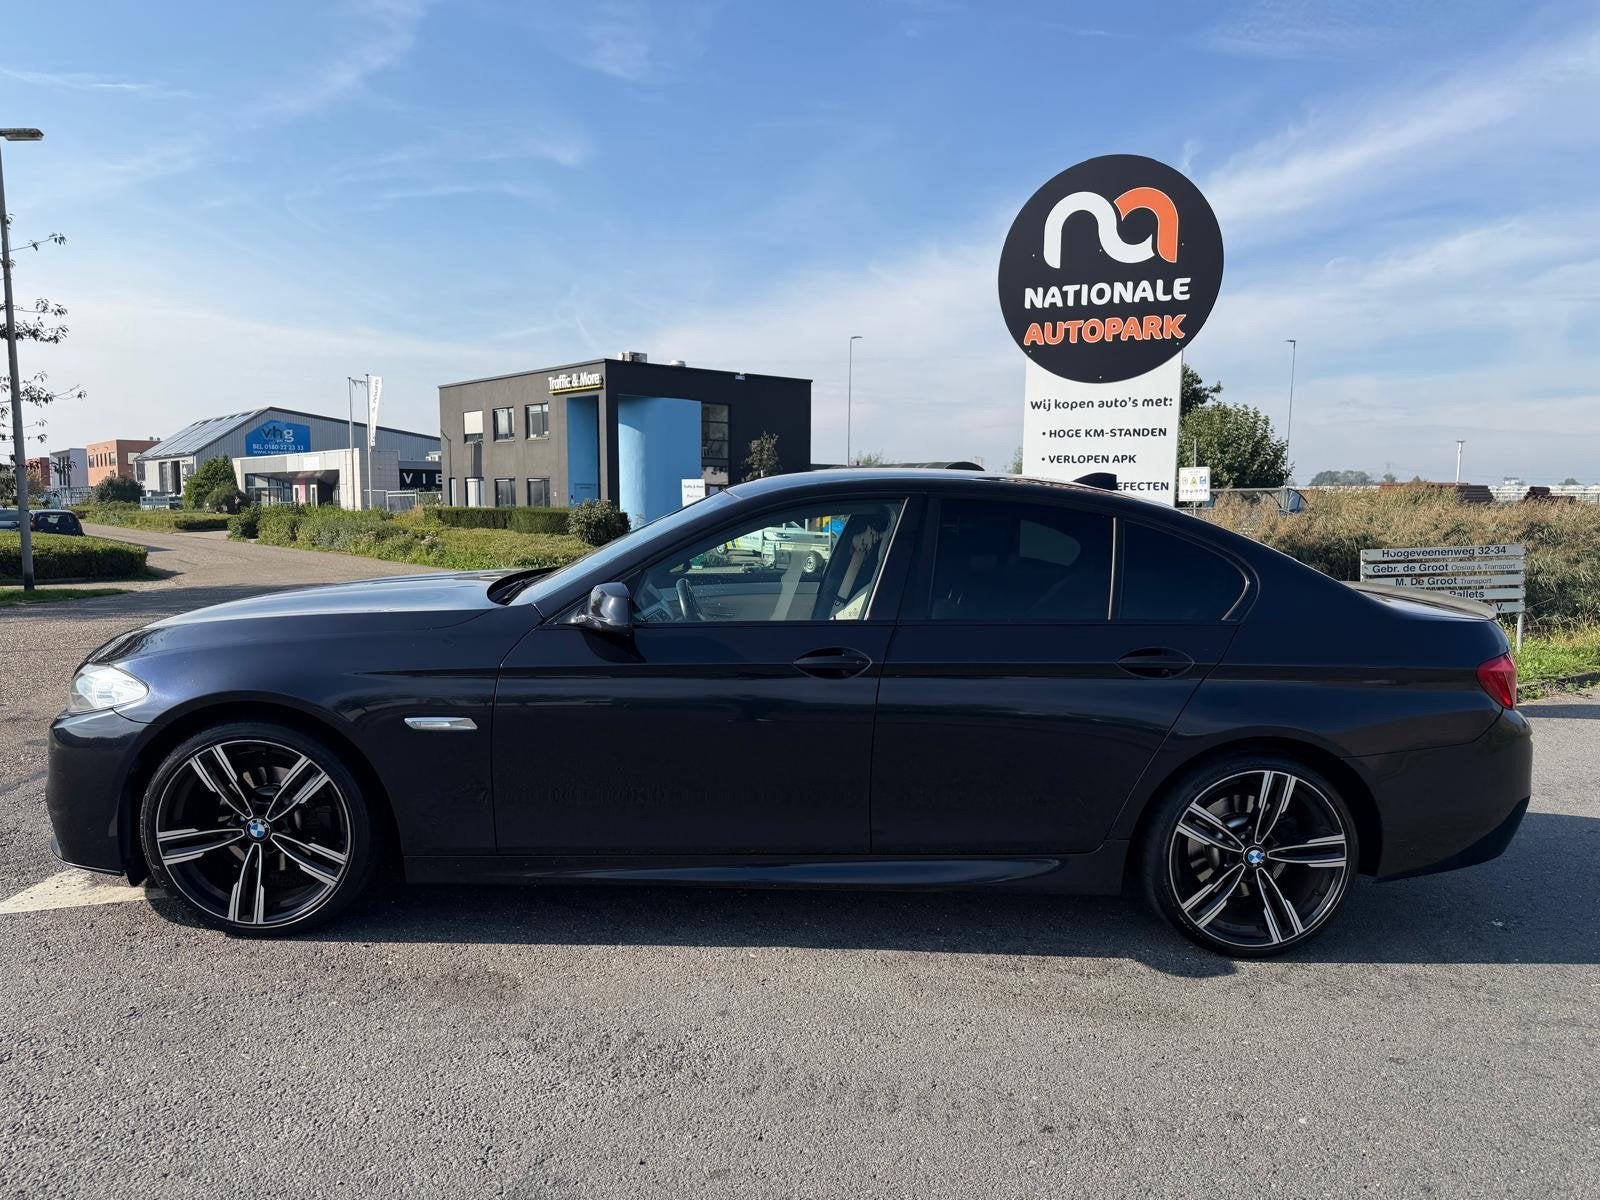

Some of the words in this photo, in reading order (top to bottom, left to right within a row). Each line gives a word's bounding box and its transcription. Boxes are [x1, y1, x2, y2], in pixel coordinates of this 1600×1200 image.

[1024, 277, 1191, 309] NATIONALE
[1023, 313, 1186, 346] AUTOPARK
[548, 374, 570, 390] Traffic
[572, 373, 578, 386] &
[580, 371, 600, 385] More
[1030, 399, 1051, 411] Wij
[1054, 399, 1094, 411] kopen
[1098, 397, 1138, 408] auto's
[1142, 396, 1173, 407] met:
[262, 425, 294, 443] vhg
[1049, 429, 1081, 438] HOGE
[1084, 427, 1167, 437] KM-STANDEN
[1048, 454, 1109, 464] VERLOPEN
[1112, 454, 1137, 463] APK
[1116, 481, 1169, 491] EFECTEN
[1382, 548, 1475, 559] Hoogeveenenweg
[1478, 546, 1506, 555] 32-34
[1372, 564, 1399, 573] Gebr.
[1403, 564, 1415, 572] de
[1418, 563, 1448, 572] Groot
[1395, 578, 1407, 586] M.
[1410, 578, 1424, 586] De
[1427, 577, 1457, 585] Groot
